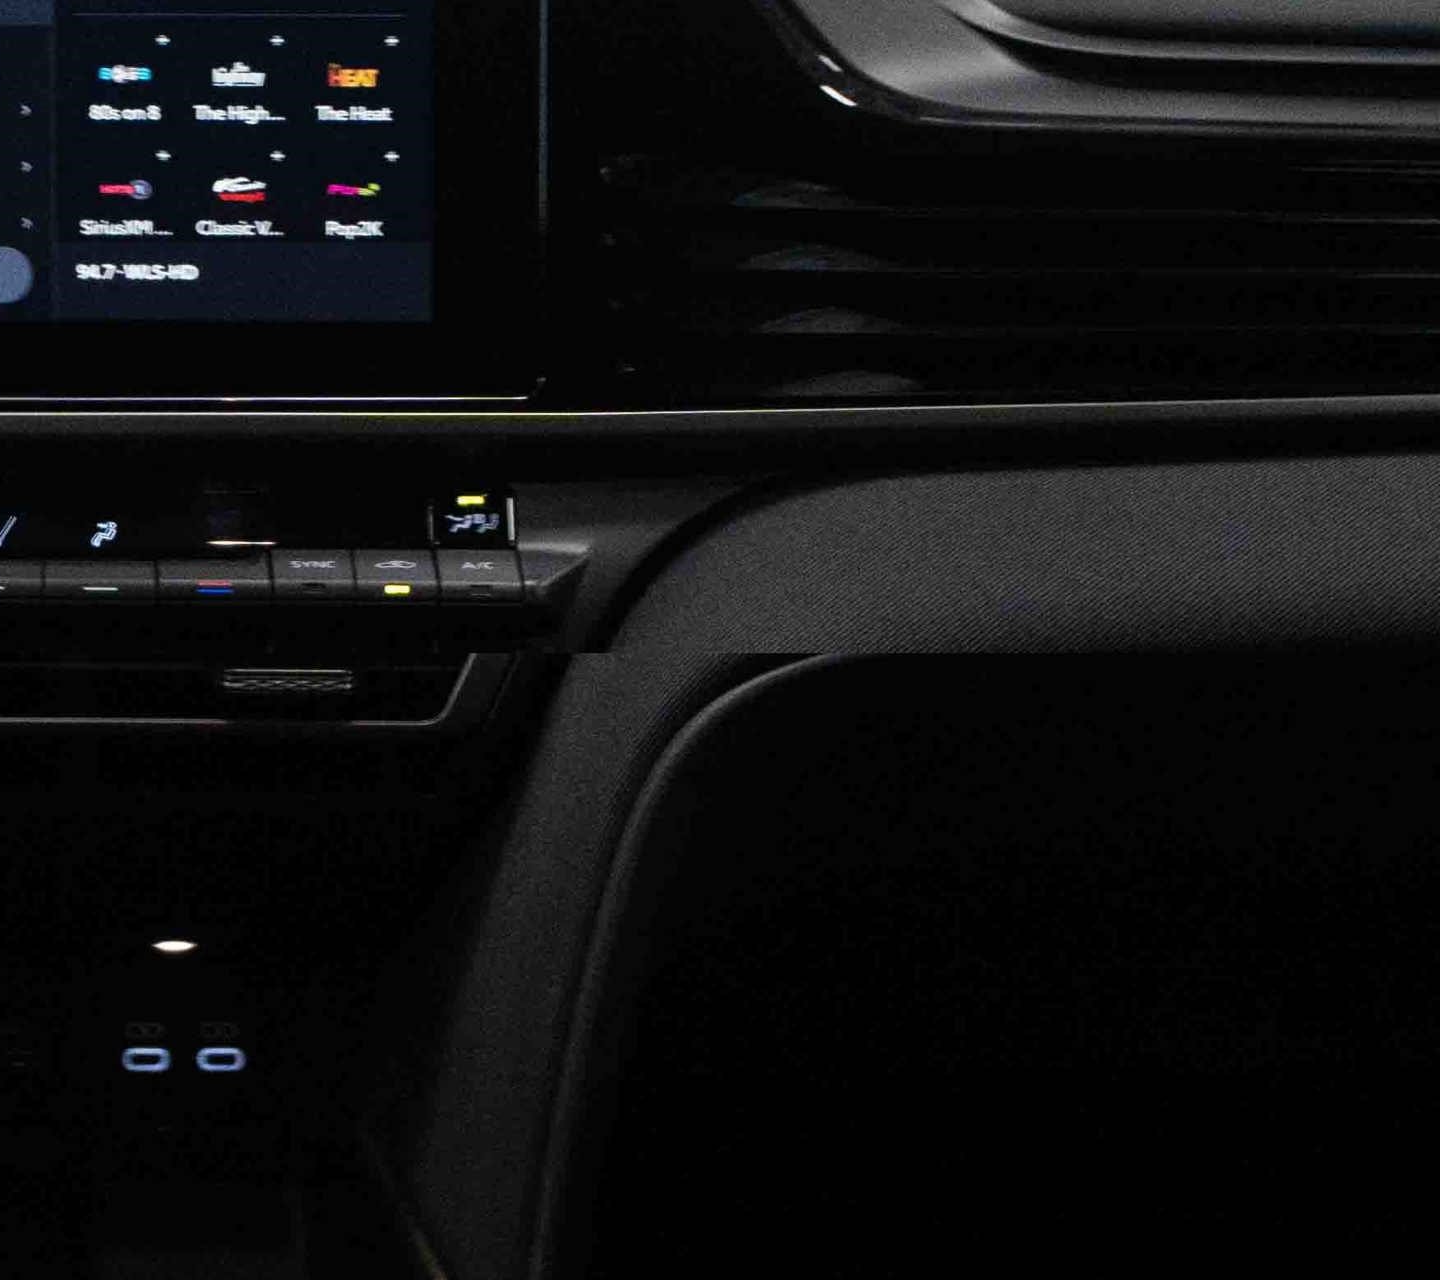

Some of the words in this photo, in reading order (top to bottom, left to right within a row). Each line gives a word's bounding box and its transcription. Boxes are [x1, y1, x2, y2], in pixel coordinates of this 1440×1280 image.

[192, 105, 227, 120] The
[314, 105, 349, 121] The
[349, 106, 394, 121] Heat
[195, 220, 256, 236] Classic
[288, 560, 338, 569] SYNC
[461, 561, 495, 570] A/C
